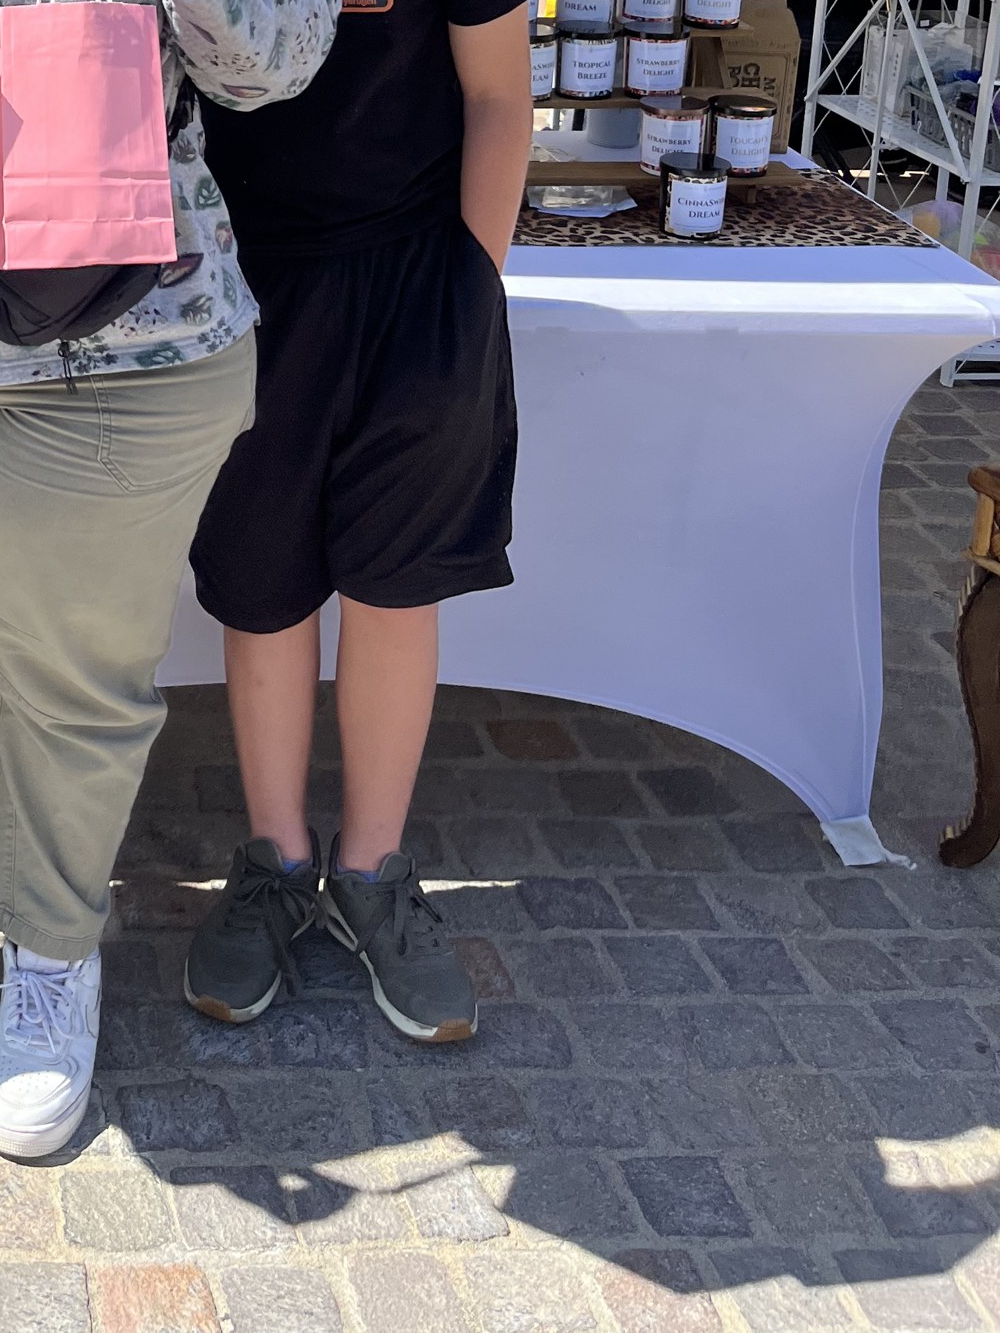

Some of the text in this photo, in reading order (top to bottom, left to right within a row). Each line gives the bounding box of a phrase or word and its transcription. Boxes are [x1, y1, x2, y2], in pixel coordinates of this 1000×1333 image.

[564, 1, 597, 12] DREAM
[636, 58, 680, 66] STRAWBERRY
[577, 71, 608, 80] BREEZE
[647, 133, 692, 145] STRAWBERRY
[731, 147, 766, 157] DELIGHT
[688, 210, 721, 219] DREAM
